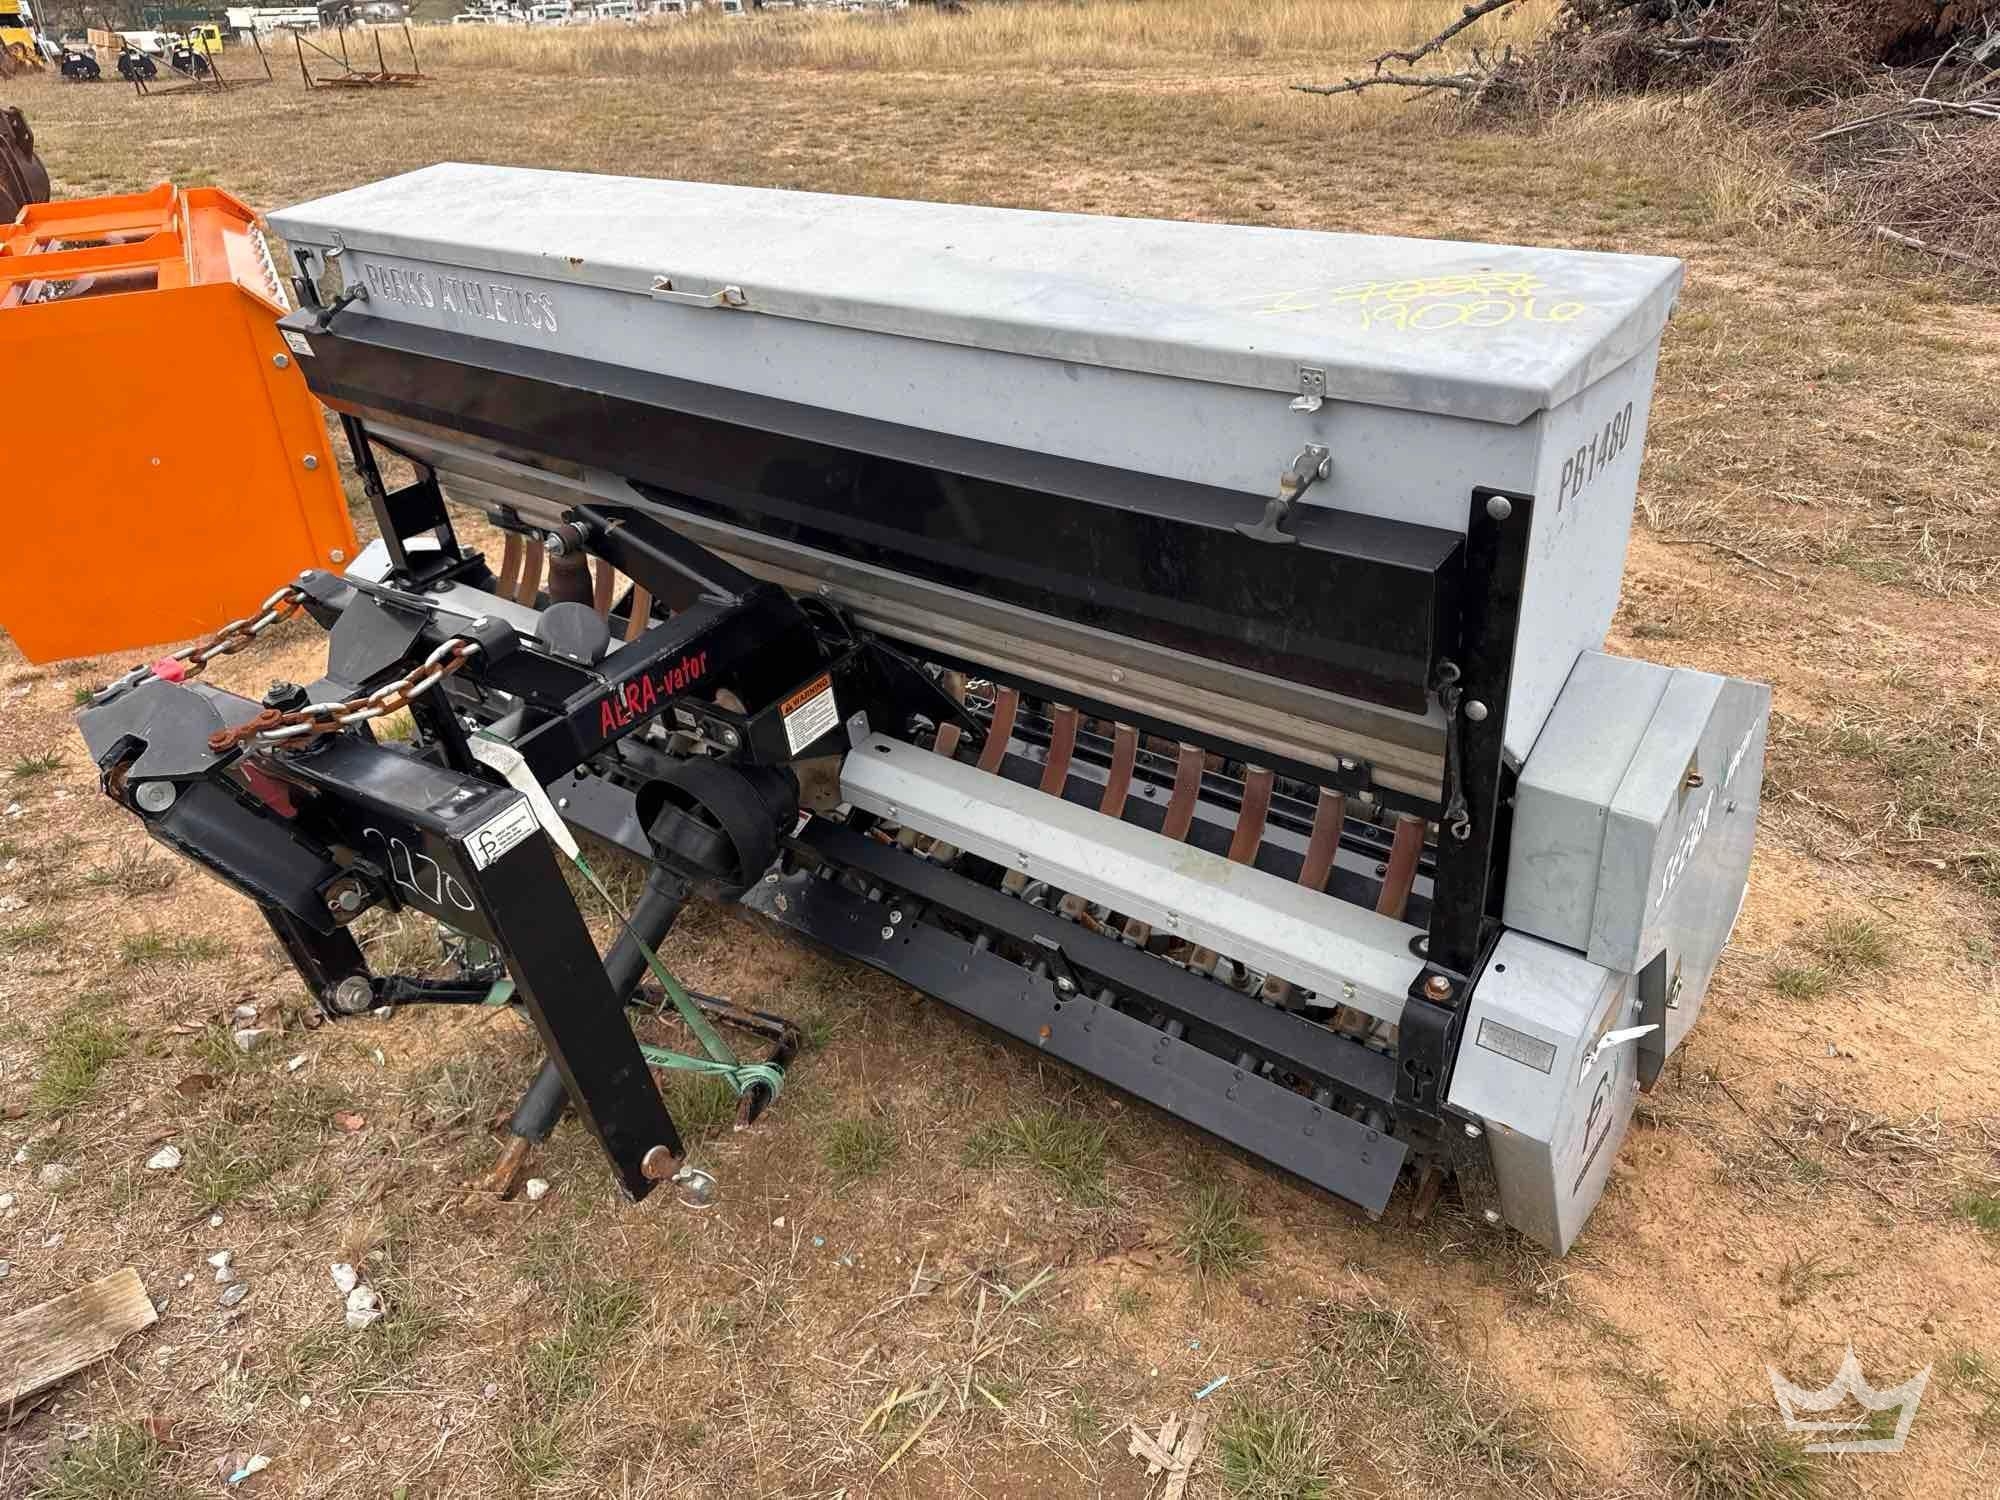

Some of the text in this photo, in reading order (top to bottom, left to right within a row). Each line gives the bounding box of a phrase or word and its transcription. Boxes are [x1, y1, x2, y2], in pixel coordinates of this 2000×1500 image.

[364, 263, 558, 333] PARKS ATHLETICS
[1557, 400, 1633, 513] PB1480
